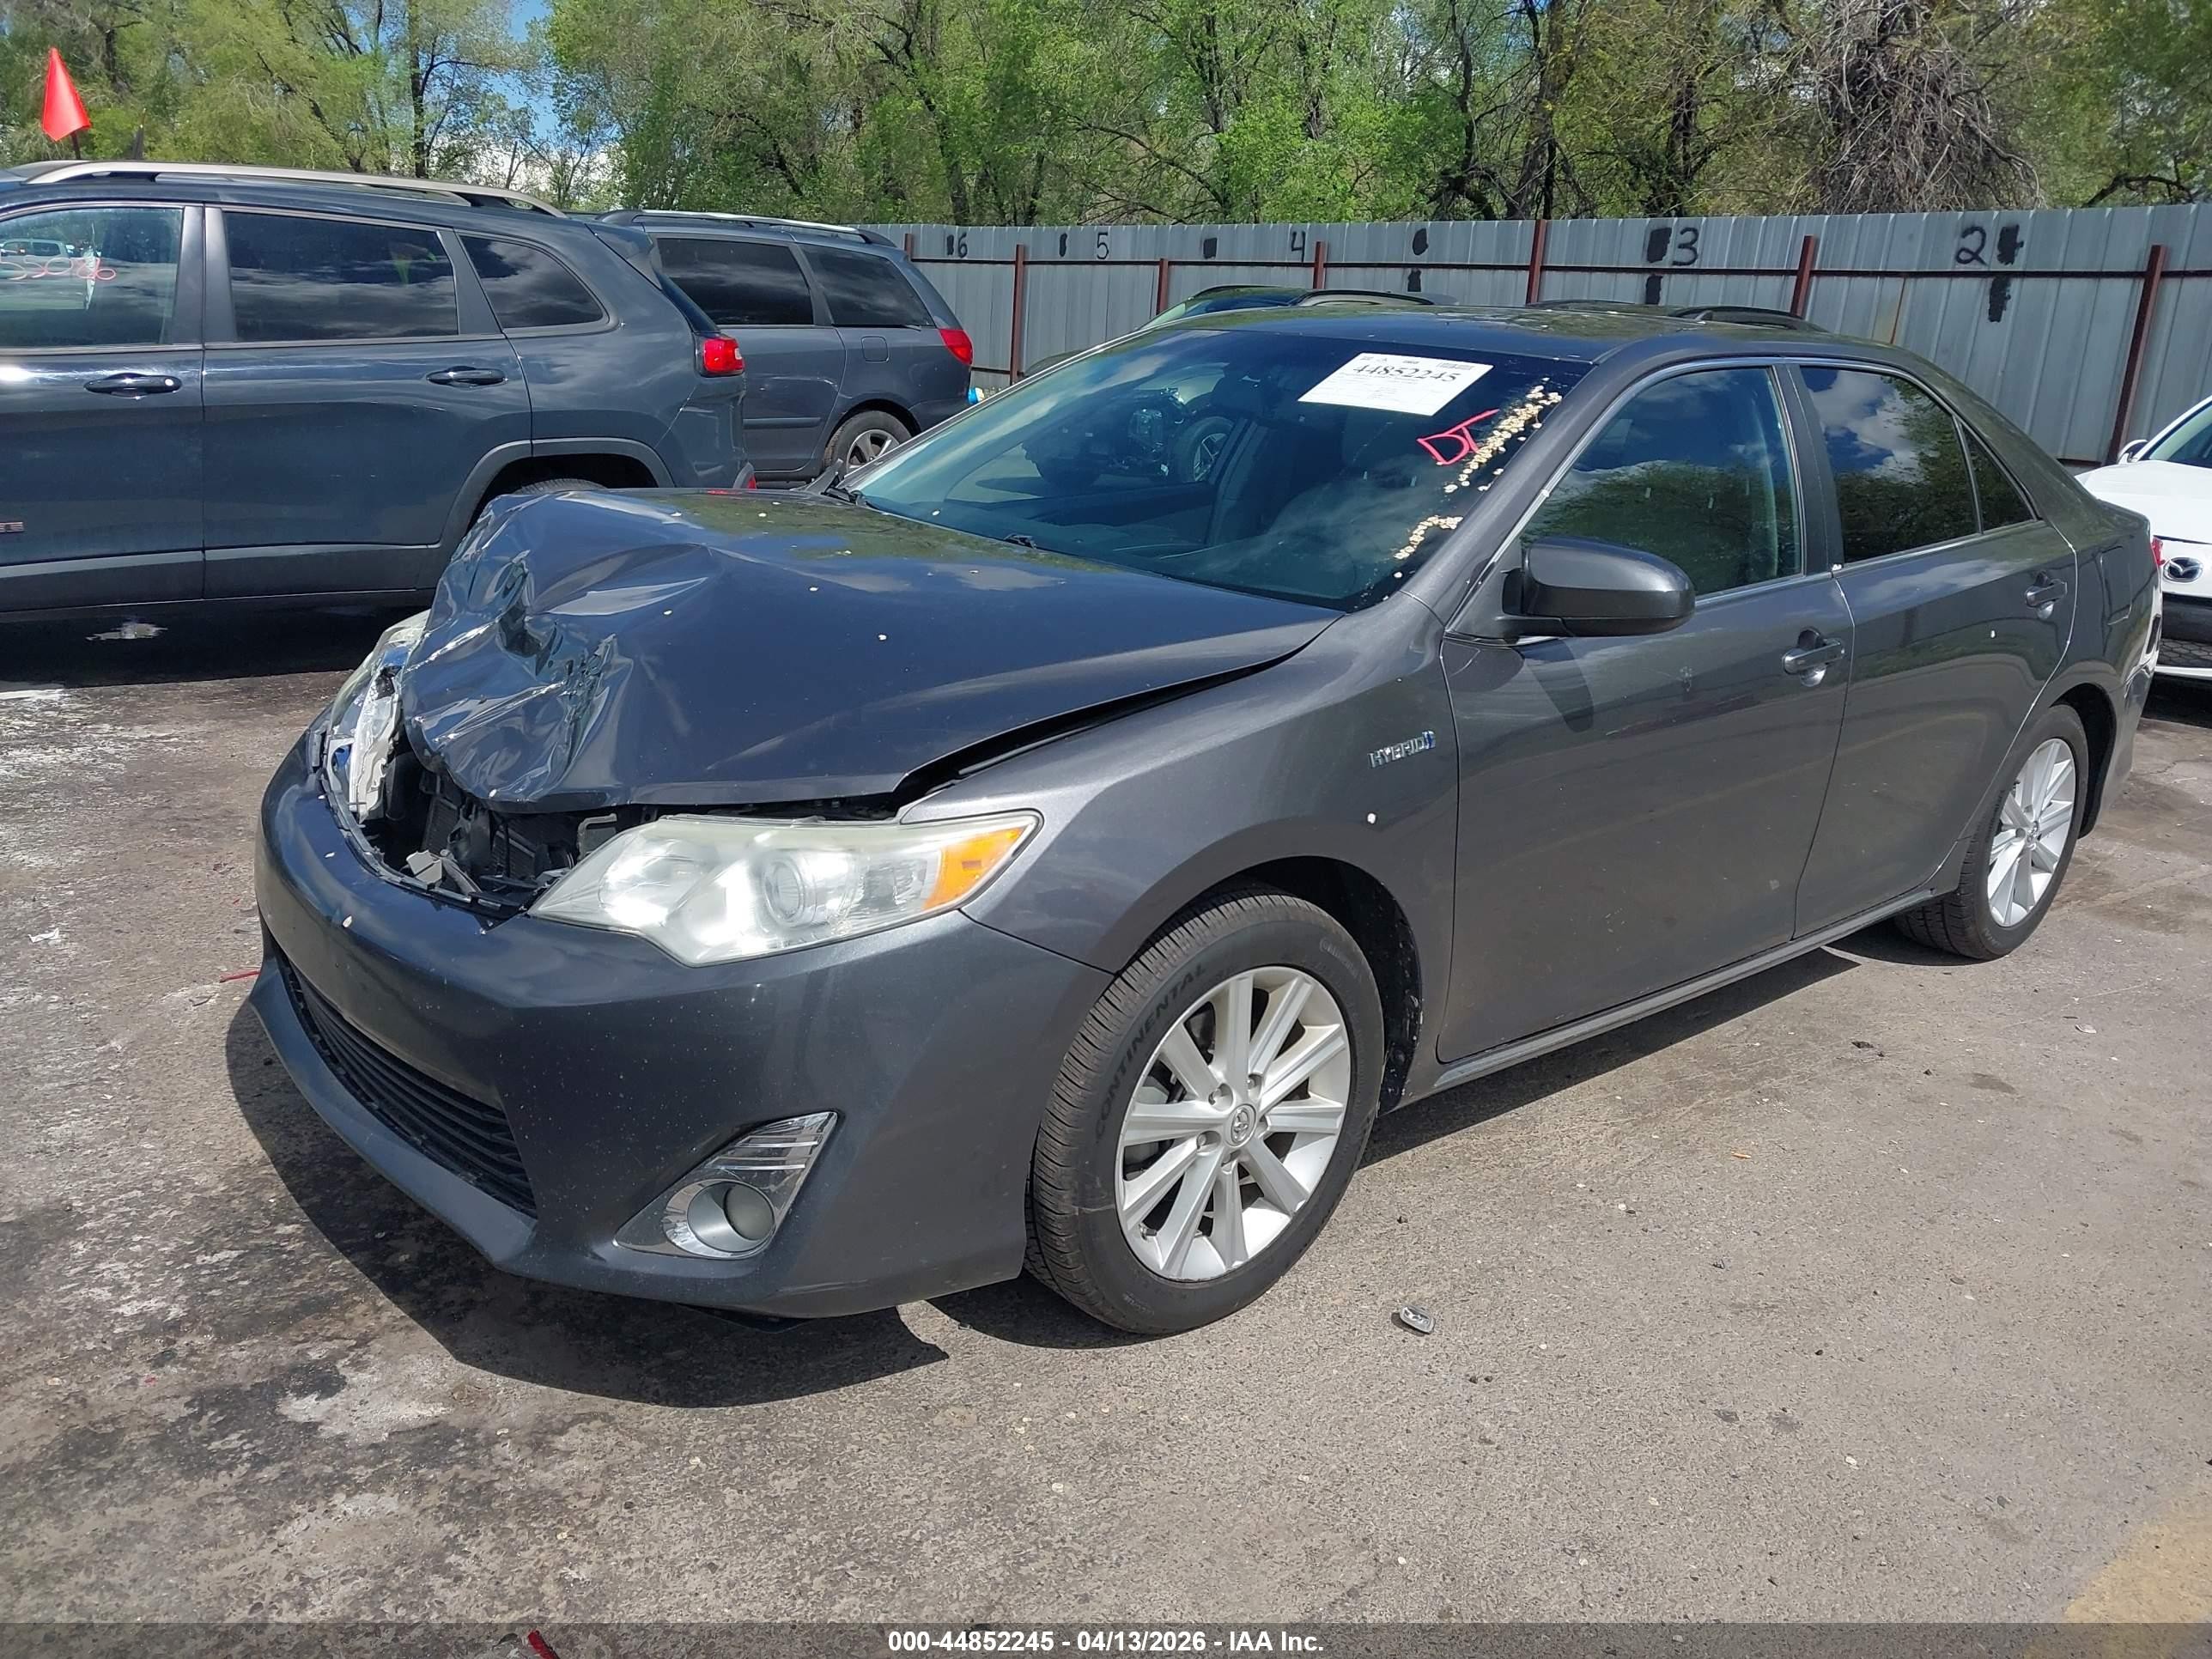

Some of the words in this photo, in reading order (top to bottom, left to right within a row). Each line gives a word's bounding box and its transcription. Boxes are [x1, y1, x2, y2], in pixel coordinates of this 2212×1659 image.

[957, 232, 969, 258] 6
[1096, 232, 1109, 259] 5
[1291, 231, 1306, 262] 4
[1672, 227, 1699, 266] 3
[1955, 226, 1988, 265] 2
[1353, 363, 1462, 382] 44852245
[1367, 735, 1425, 768] HYBRID
[1095, 963, 1206, 1144] CONTINENTAL
